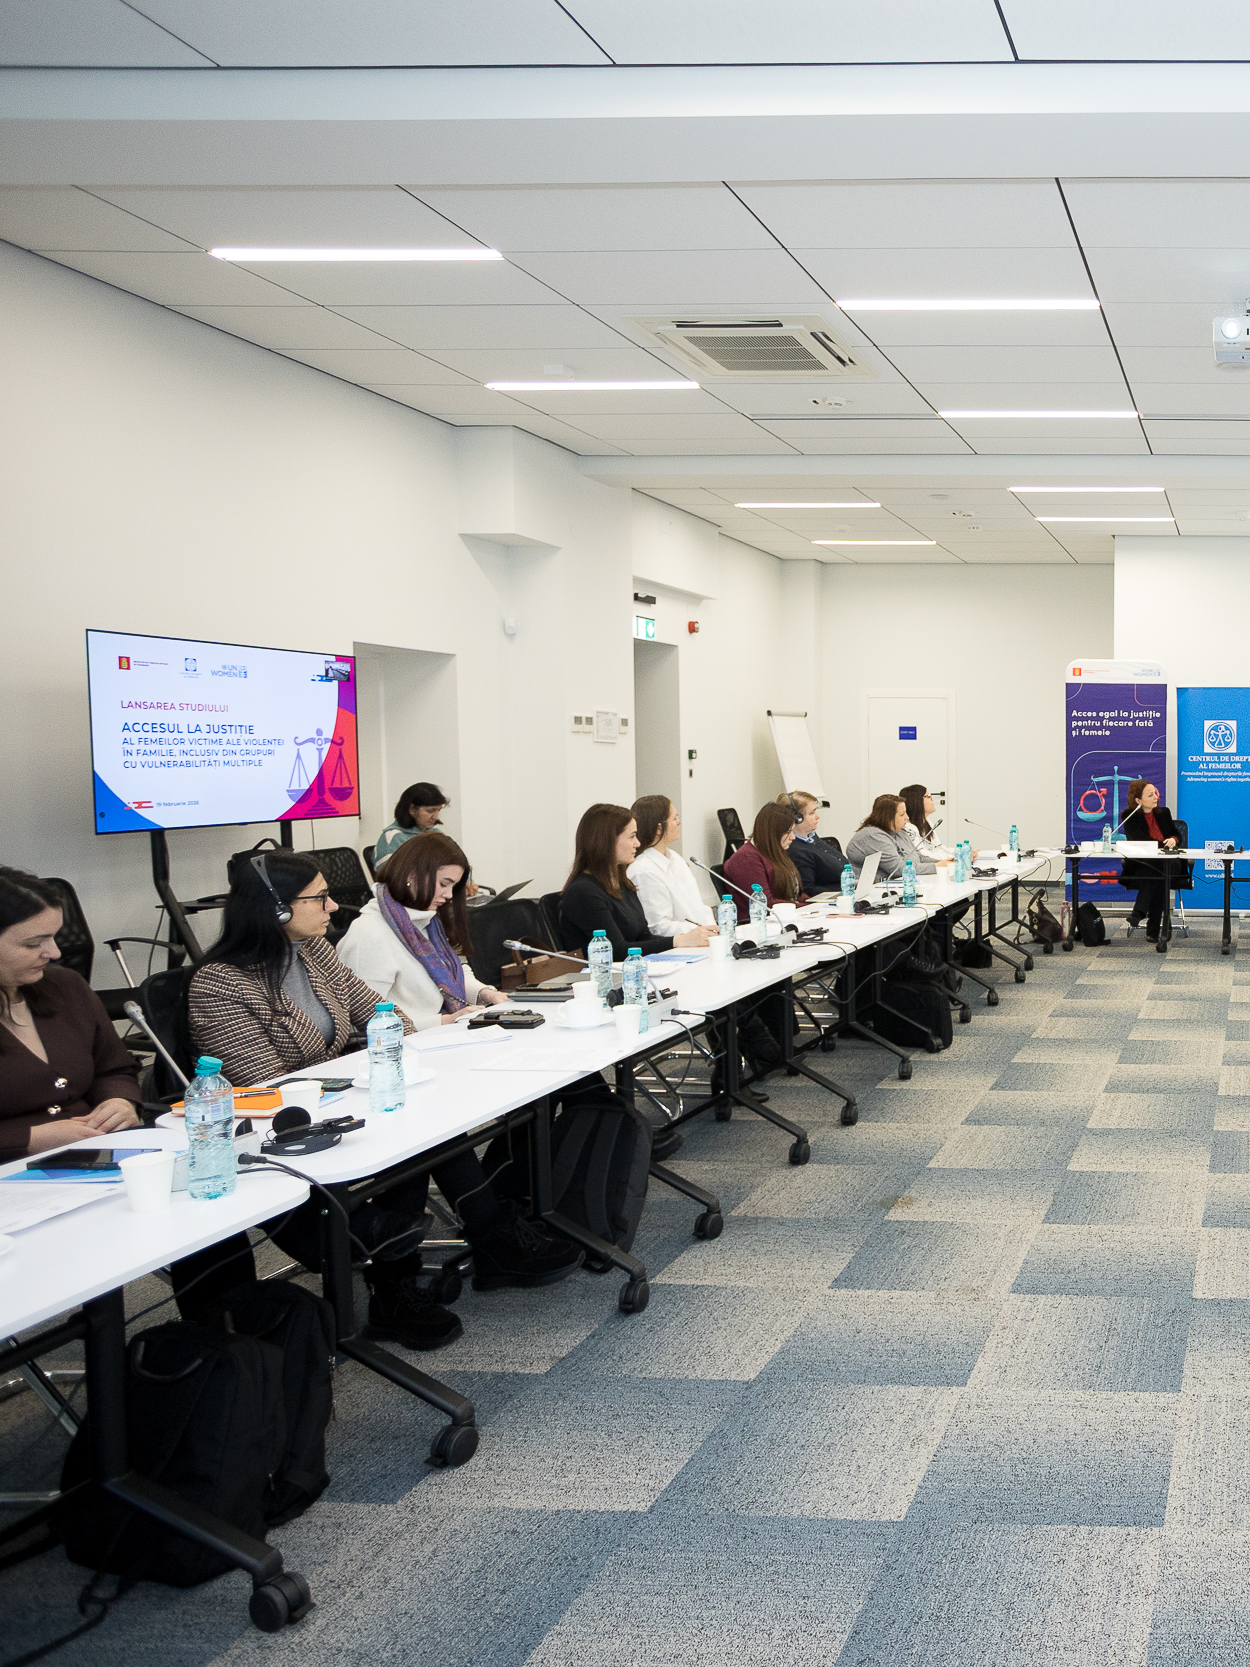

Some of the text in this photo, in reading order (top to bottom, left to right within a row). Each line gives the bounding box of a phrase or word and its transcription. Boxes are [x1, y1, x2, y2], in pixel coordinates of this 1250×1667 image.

[211, 670, 238, 678] WOMEN
[121, 700, 228, 712] LANSAREA STUDIULUI
[1071, 710, 1097, 718] Acces
[1098, 710, 1118, 718] egal
[122, 722, 255, 737] ACCESUL LA JUSTIȚIE
[1071, 720, 1100, 728] pentru
[122, 737, 134, 746] AL
[138, 738, 186, 746] FEMEILOR
[188, 738, 224, 746] VICTIME
[244, 738, 284, 748] VIOLENȚEI
[122, 746, 133, 756] ÎN
[136, 748, 177, 758] FAMILIE,
[179, 748, 220, 756] INCLUSIV
[240, 748, 276, 756] GRUPURI
[123, 758, 263, 770] CU VULNERABILITĂȚI MULTIPLE
